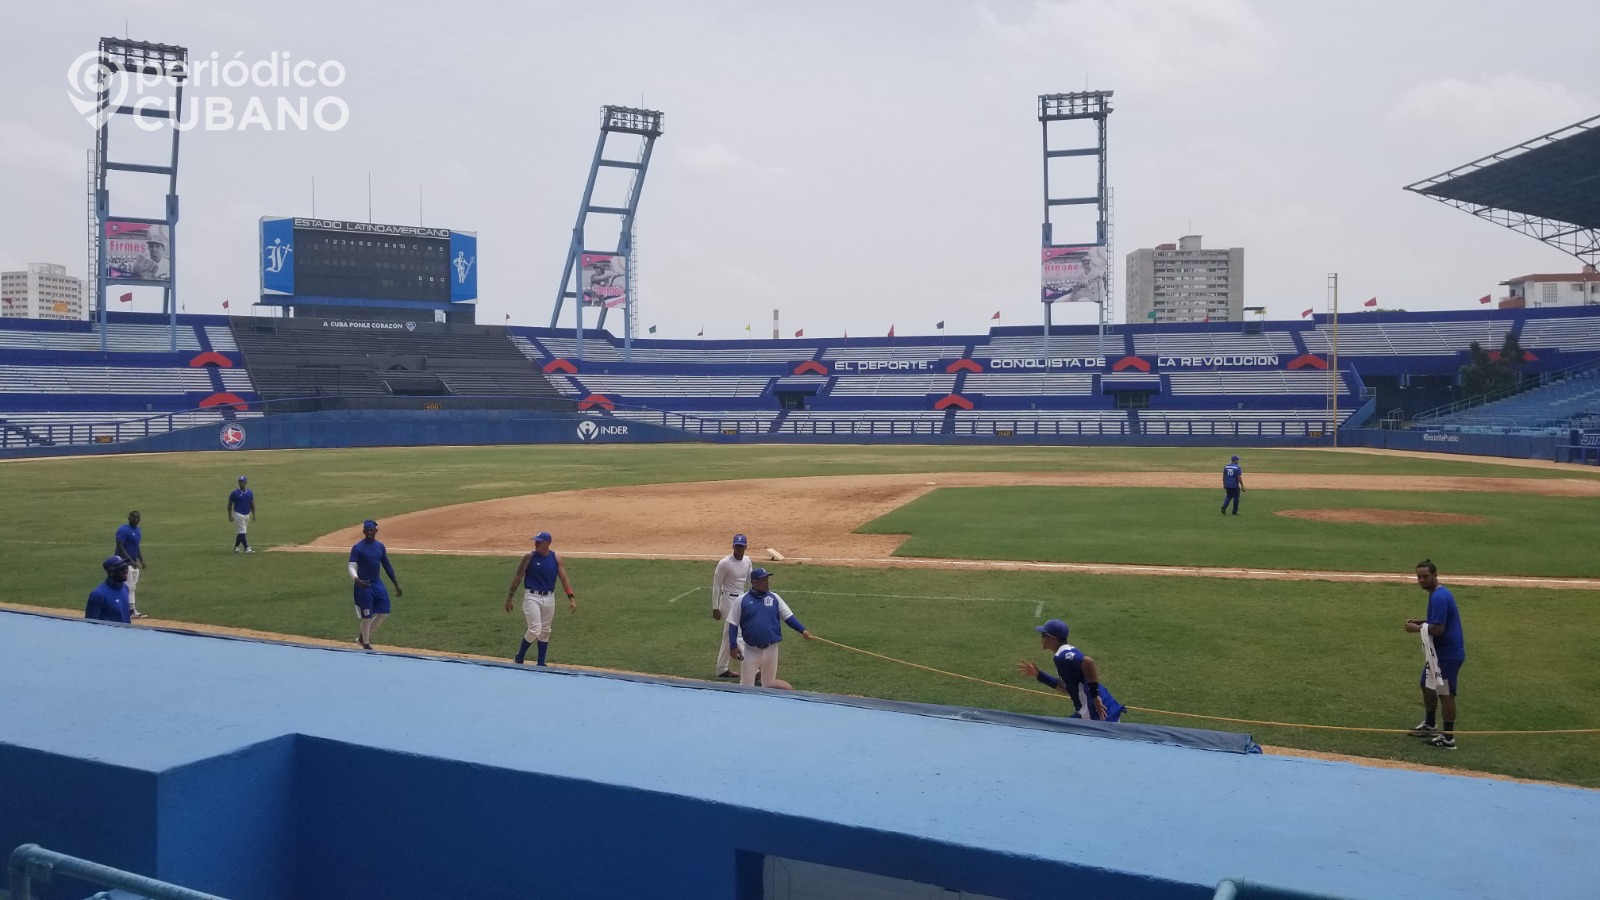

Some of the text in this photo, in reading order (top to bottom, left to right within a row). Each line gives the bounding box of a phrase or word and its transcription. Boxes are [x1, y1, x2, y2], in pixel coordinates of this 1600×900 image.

[294, 218, 449, 237] ESTADIO LATINOAMERICANO
[110, 240, 146, 253] Firmes
[834, 360, 853, 371] EL
[990, 357, 1106, 369] CONQUISTA DE
[1157, 356, 1279, 367] LA REVOLUCION
[600, 425, 629, 435] INDER
